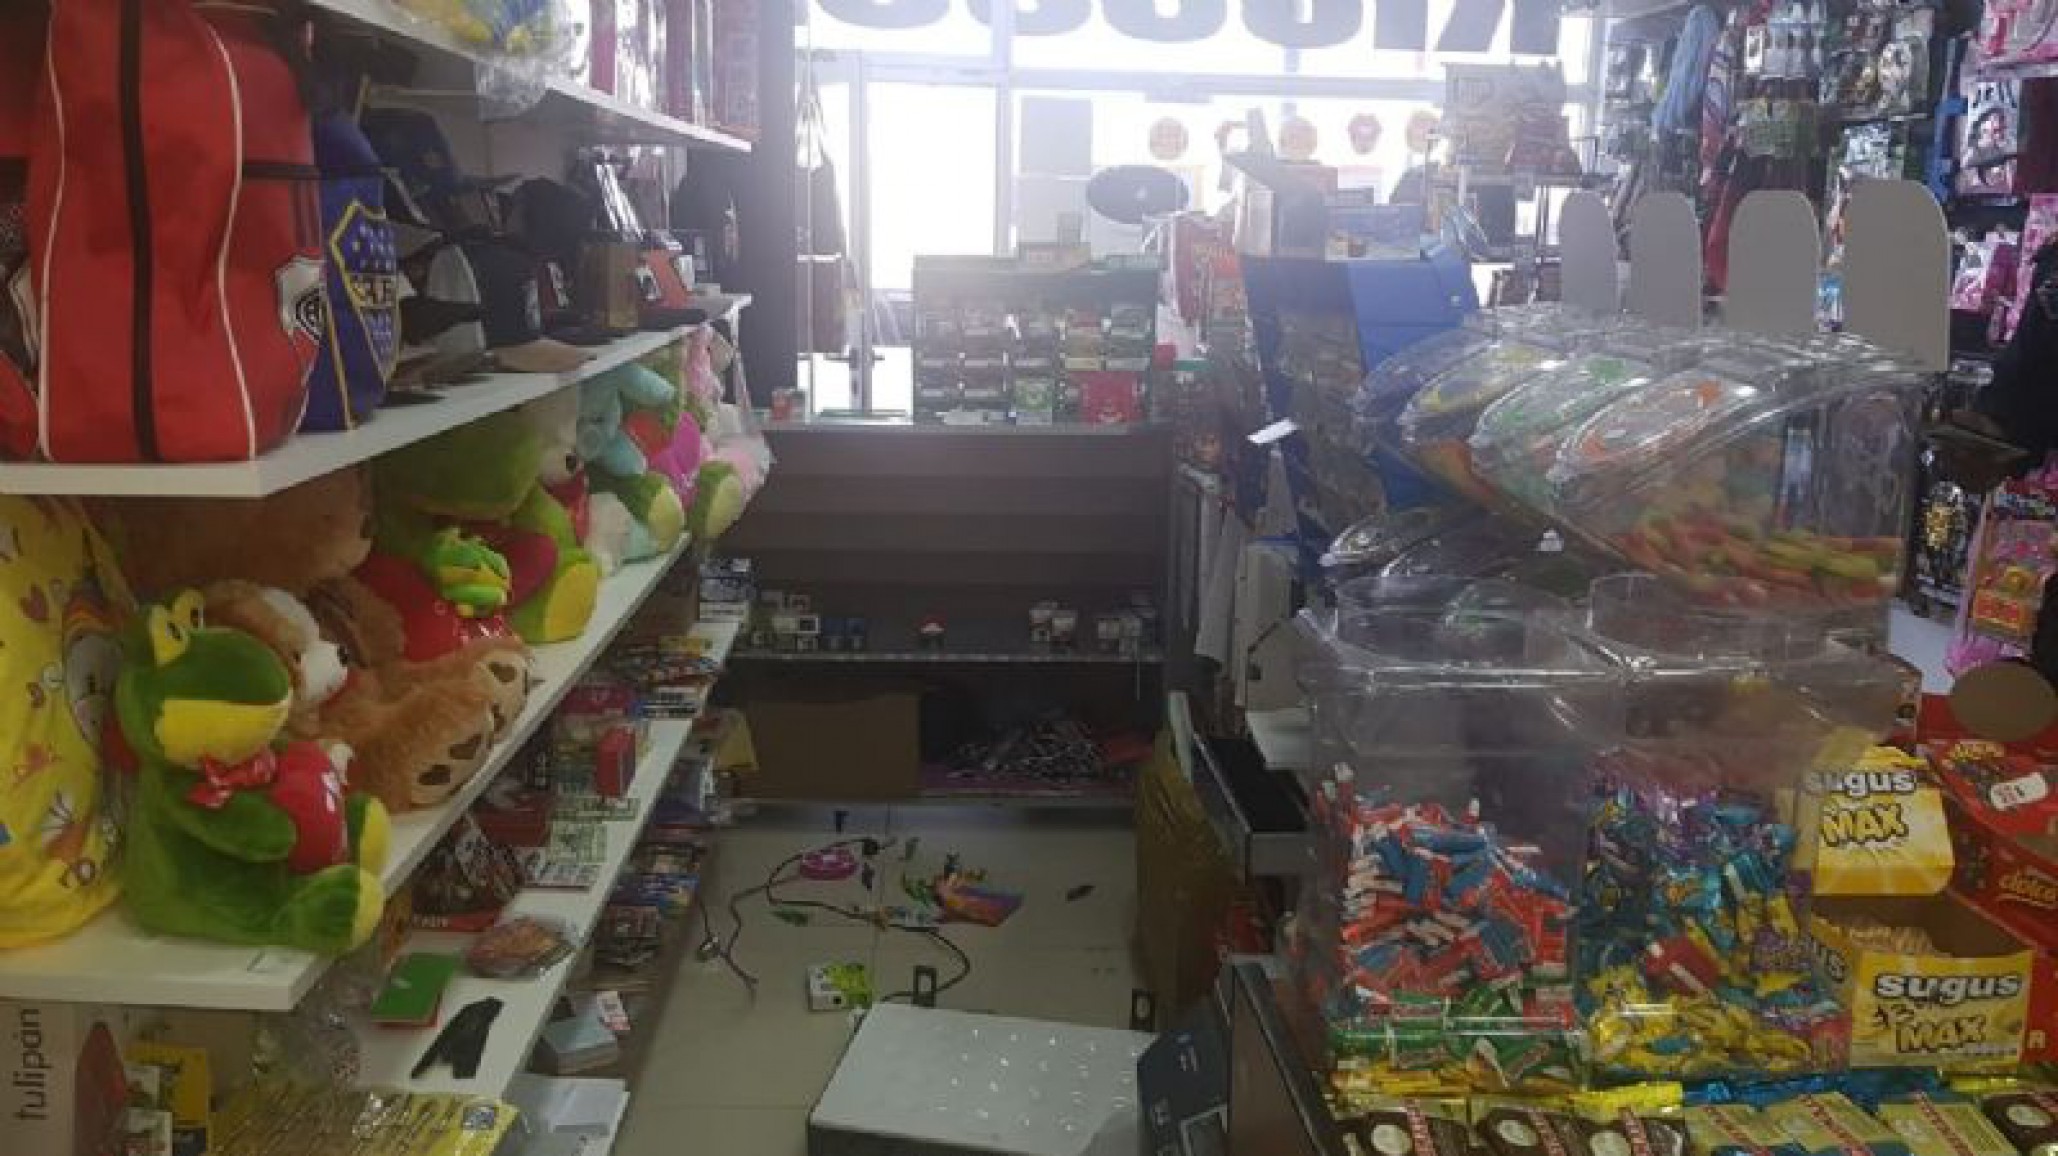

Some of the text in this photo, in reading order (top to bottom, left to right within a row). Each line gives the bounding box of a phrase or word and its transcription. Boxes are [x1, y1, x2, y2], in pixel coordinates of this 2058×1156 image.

[1804, 770, 1917, 798] sugus
[1820, 803, 1910, 848] MAX
[1874, 973, 2020, 1007] sugus
[1895, 1014, 1988, 1054] MAX
[14, 1008, 53, 1120] tulipán
